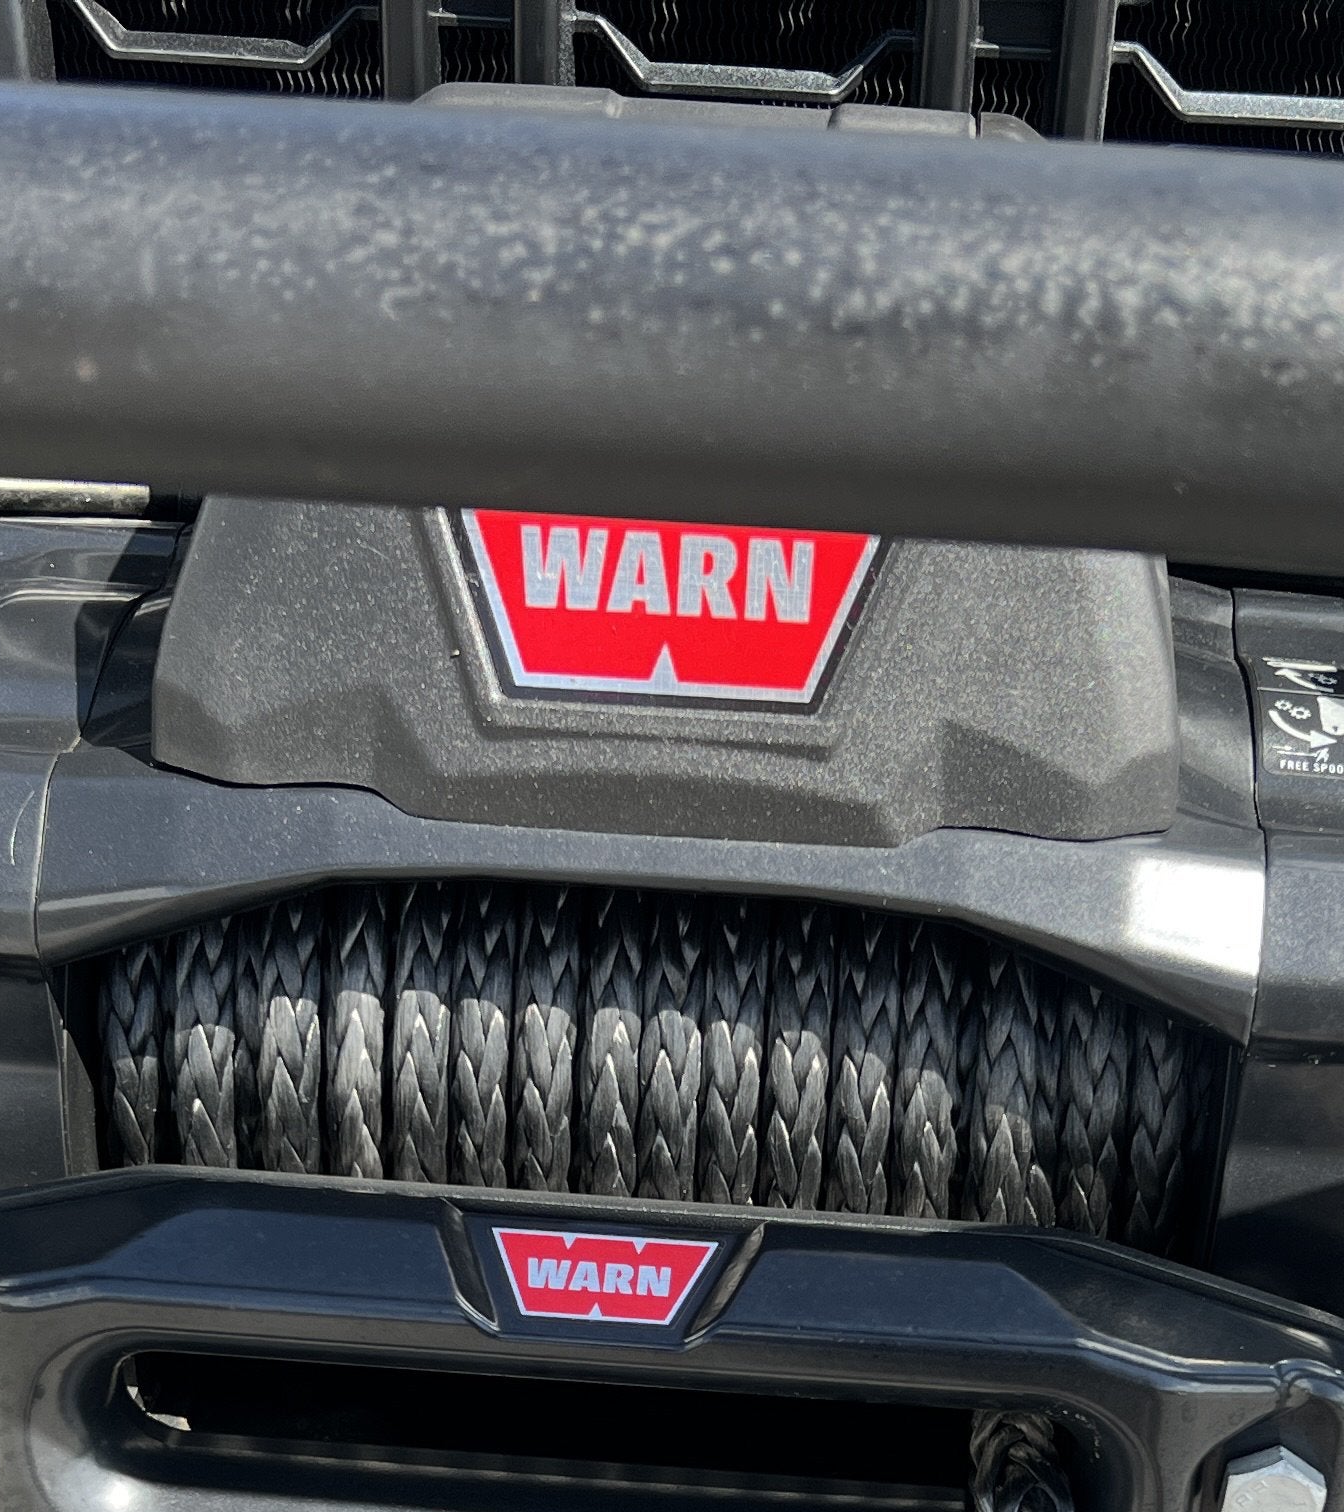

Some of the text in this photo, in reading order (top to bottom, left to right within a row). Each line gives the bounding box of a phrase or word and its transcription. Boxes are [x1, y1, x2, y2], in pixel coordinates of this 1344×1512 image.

[519, 523, 816, 624] WARN
[1279, 759, 1309, 772] FREE
[527, 1257, 672, 1297] WARN
